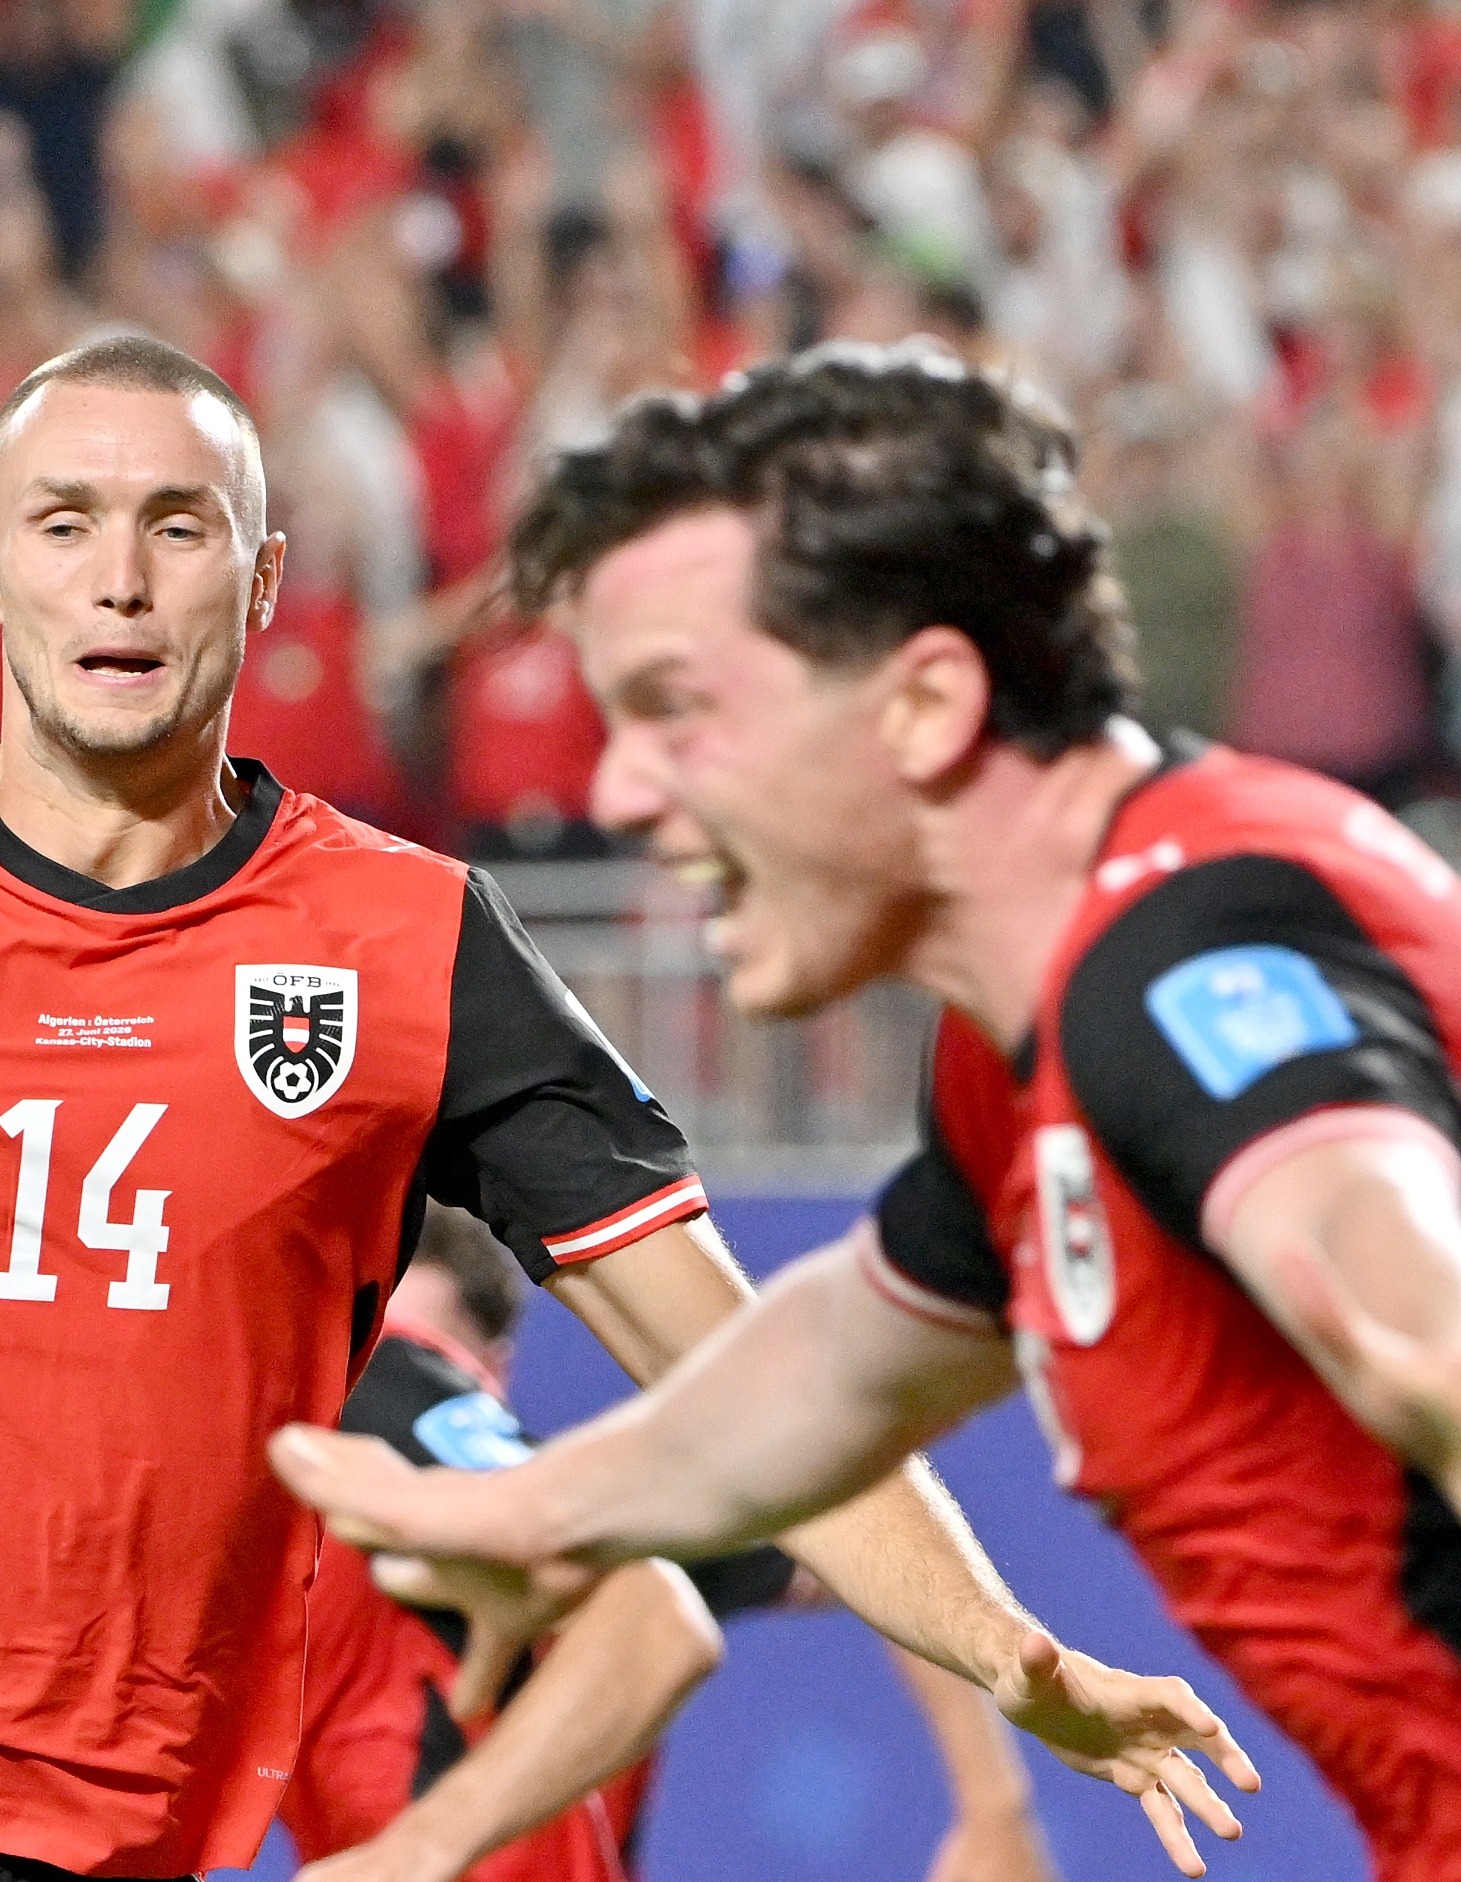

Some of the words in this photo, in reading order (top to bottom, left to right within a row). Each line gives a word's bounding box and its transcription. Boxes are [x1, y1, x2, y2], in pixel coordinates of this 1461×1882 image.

[272, 972, 322, 988] ÖFB
[37, 1013, 86, 1027] Algerien
[94, 1015, 155, 1027] Österreich
[76, 1028, 101, 1036] Juni
[103, 1026, 132, 1035] 2026
[35, 1036, 152, 1048] Kansas-City-Stadion
